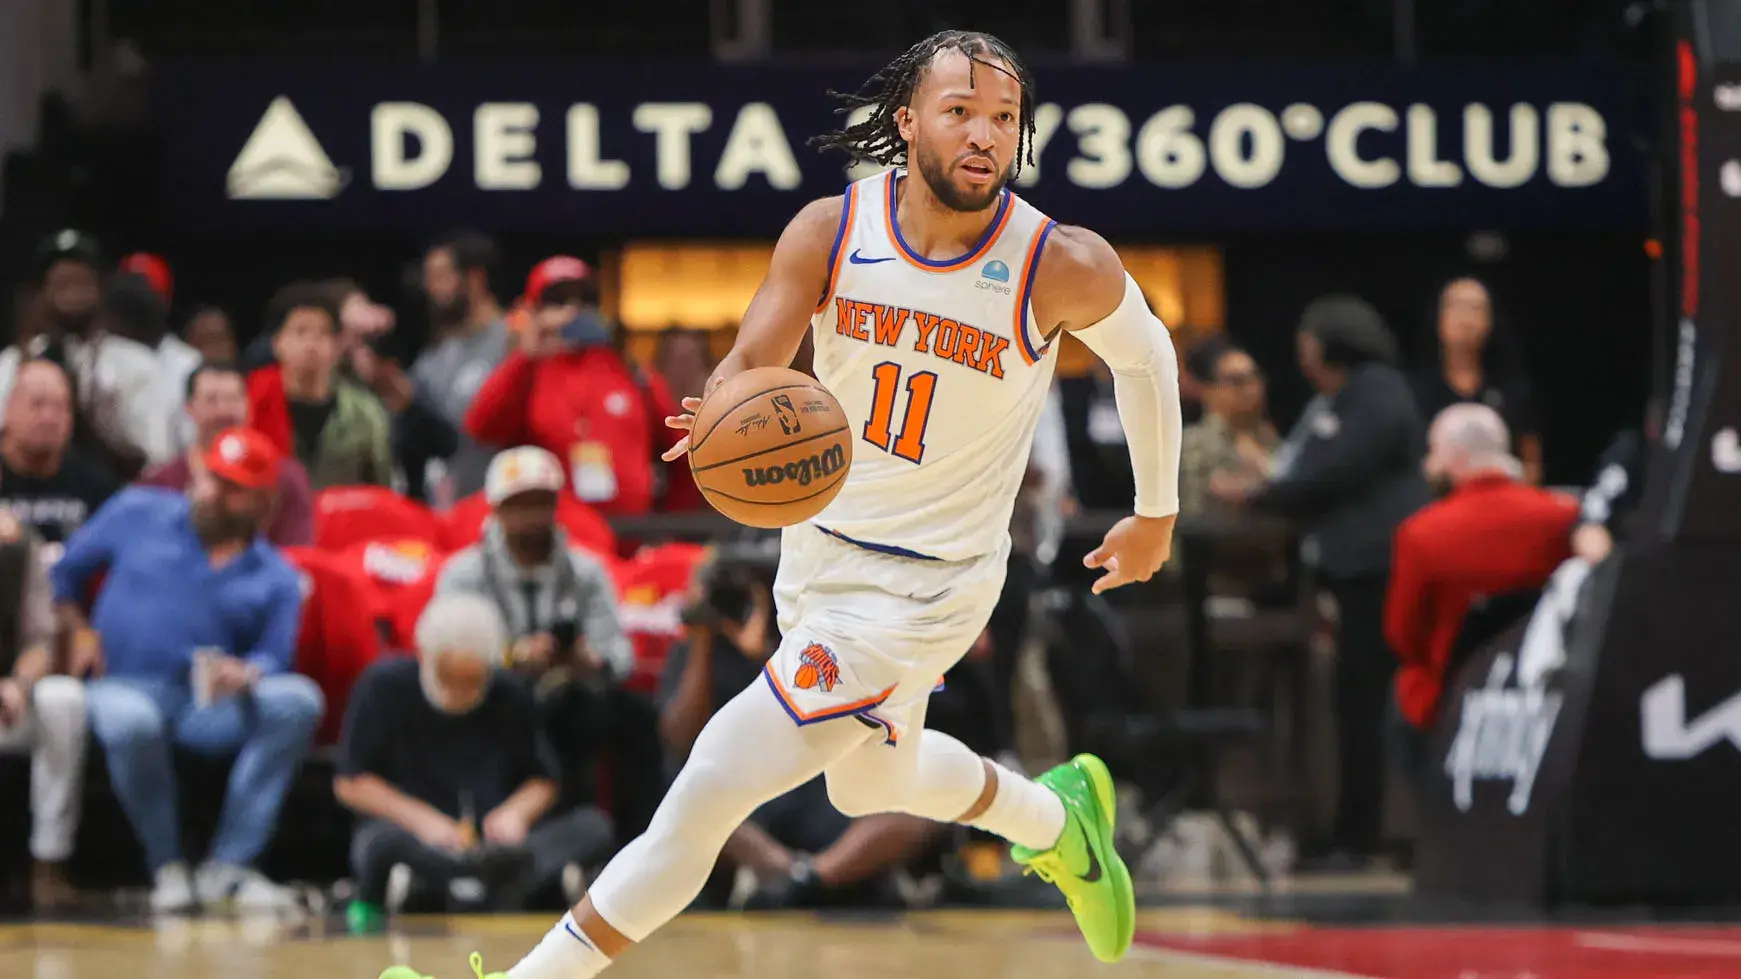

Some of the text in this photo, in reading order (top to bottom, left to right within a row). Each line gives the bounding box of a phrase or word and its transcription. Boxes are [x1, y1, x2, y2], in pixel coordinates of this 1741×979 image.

[370, 102, 802, 190] DELTA
[974, 280, 1011, 295] sphere
[835, 297, 1011, 380] NEW YORK
[862, 360, 939, 465] 11
[742, 442, 846, 488] Wilson
